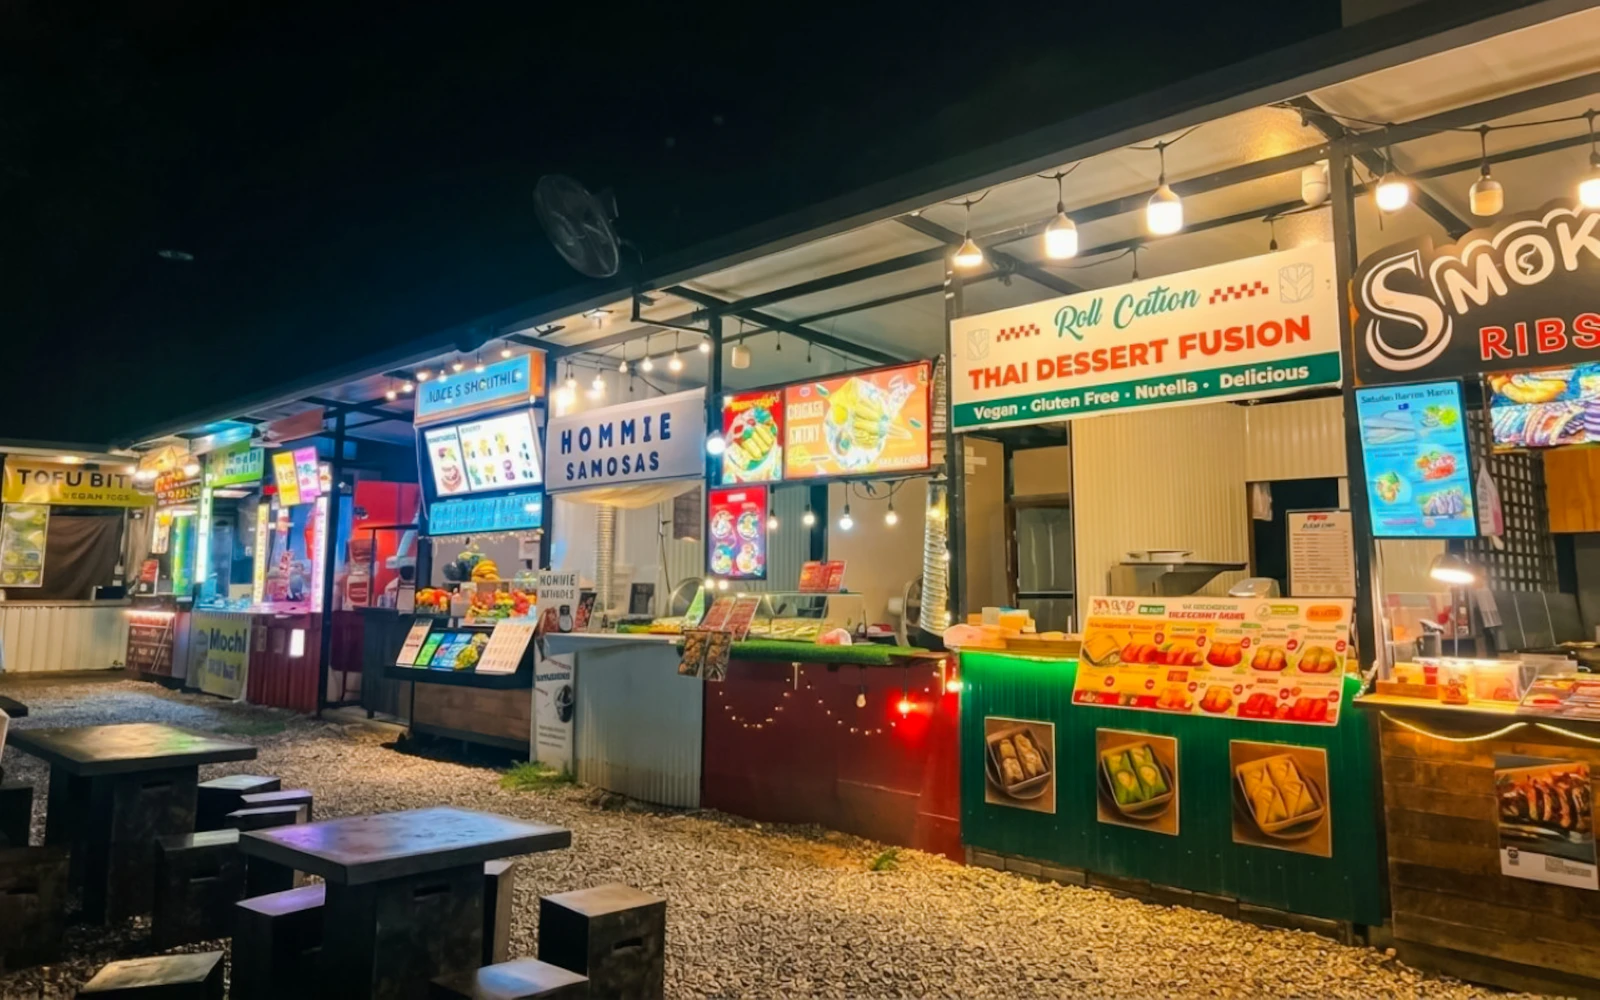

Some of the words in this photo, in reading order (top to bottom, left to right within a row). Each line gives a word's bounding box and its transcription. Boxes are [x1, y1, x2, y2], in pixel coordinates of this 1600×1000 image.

[1054, 297, 1103, 341] Roll
[1113, 286, 1200, 329] Cation
[1479, 312, 1600, 361] RIBS
[968, 362, 1028, 390] THAI
[1036, 338, 1169, 381] DESSERT
[1178, 315, 1311, 360] FUSION
[974, 403, 1018, 421] Vegan
[1030, 392, 1081, 413] Gluten
[1084, 389, 1120, 406] Free
[1135, 379, 1198, 400] Nutella
[1219, 365, 1310, 389] Delicious
[561, 412, 671, 455] HOMMIE
[17, 469, 82, 487] TOFU
[566, 451, 659, 481] SAMOSAS
